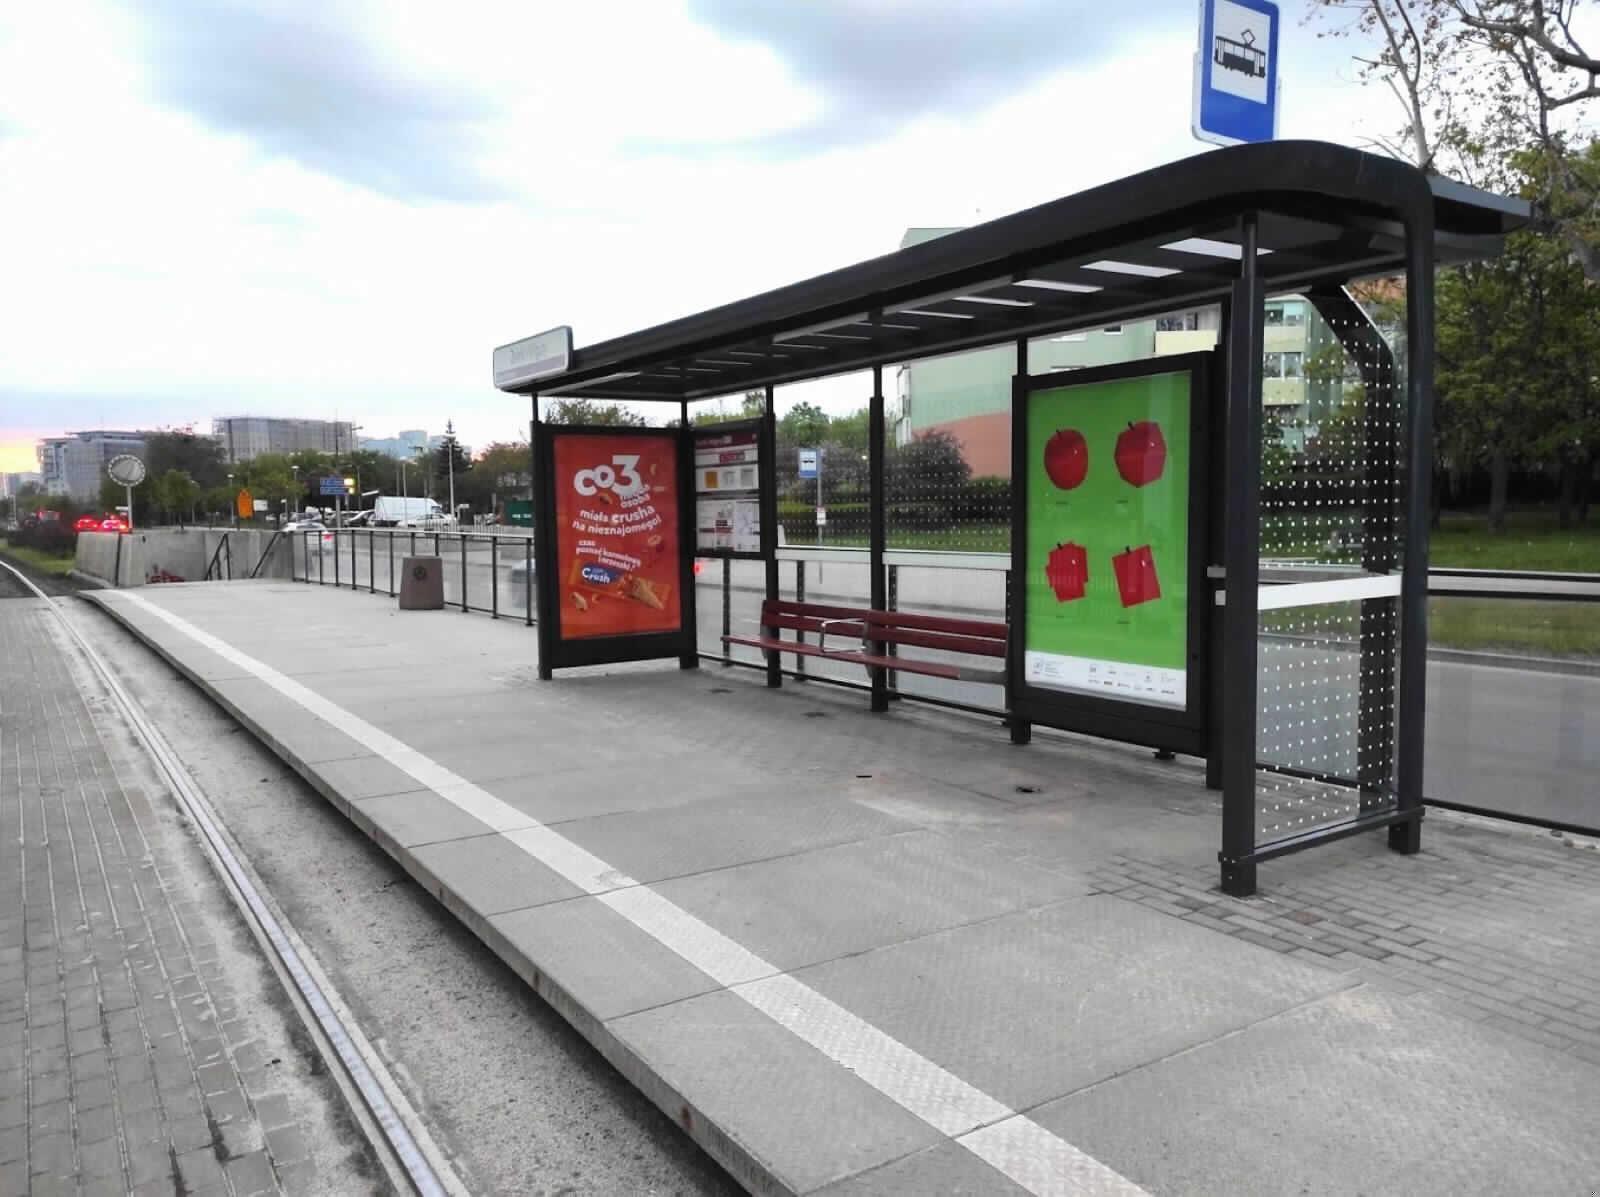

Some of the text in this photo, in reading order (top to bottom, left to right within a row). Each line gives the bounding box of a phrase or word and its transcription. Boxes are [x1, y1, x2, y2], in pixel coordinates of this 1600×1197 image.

[611, 505, 655, 523] crusha
[572, 520, 585, 531] na
[582, 567, 611, 584] Crush
